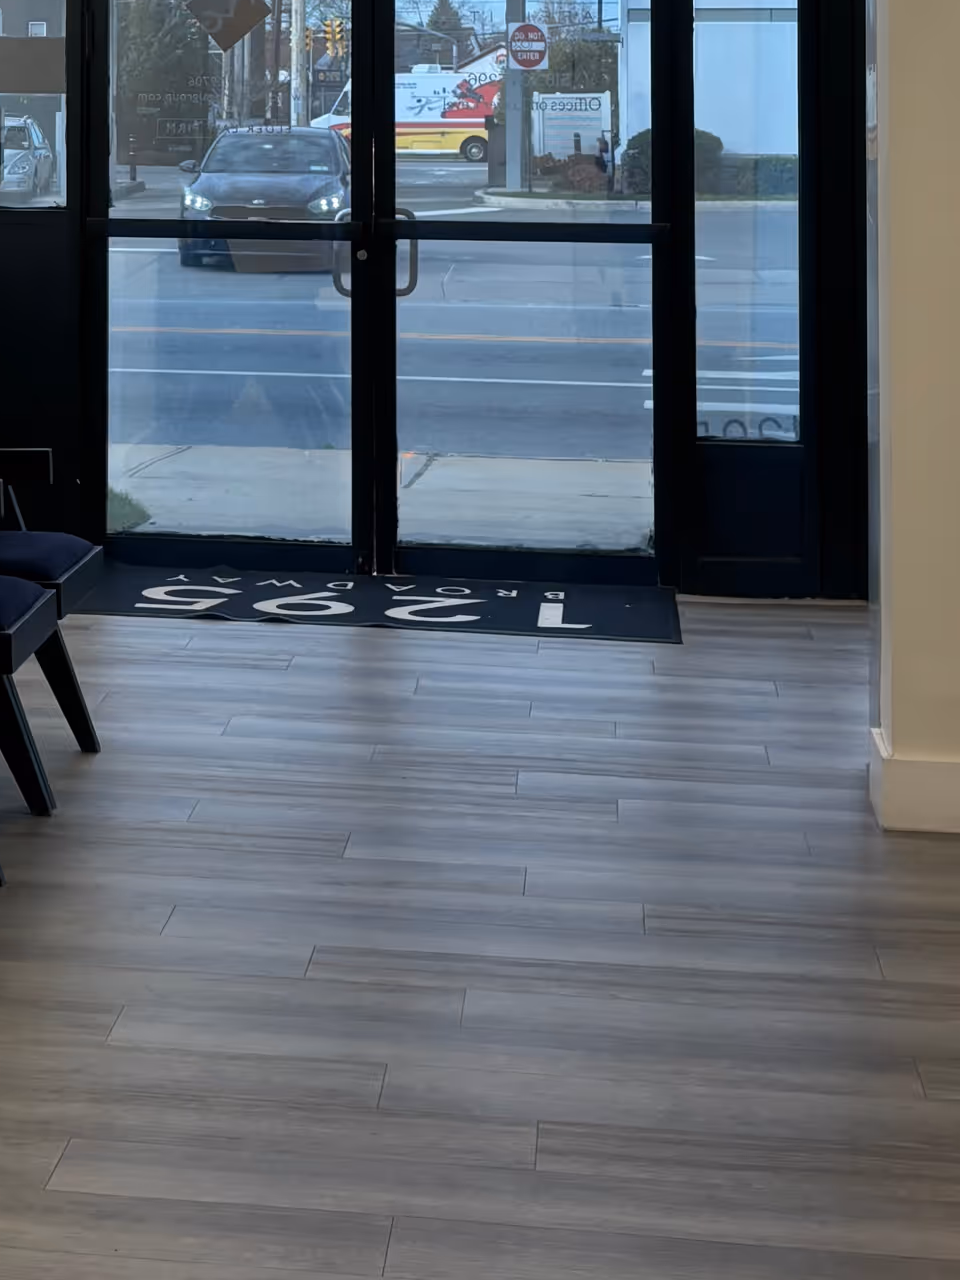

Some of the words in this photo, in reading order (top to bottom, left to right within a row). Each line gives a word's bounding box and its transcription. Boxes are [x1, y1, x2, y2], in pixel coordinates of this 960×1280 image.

[514, 31, 525, 40] DO
[527, 31, 542, 40] NOT
[517, 51, 540, 60] ENTER
[166, 574, 565, 600] BROADWAY
[134, 585, 592, 629] 1295
